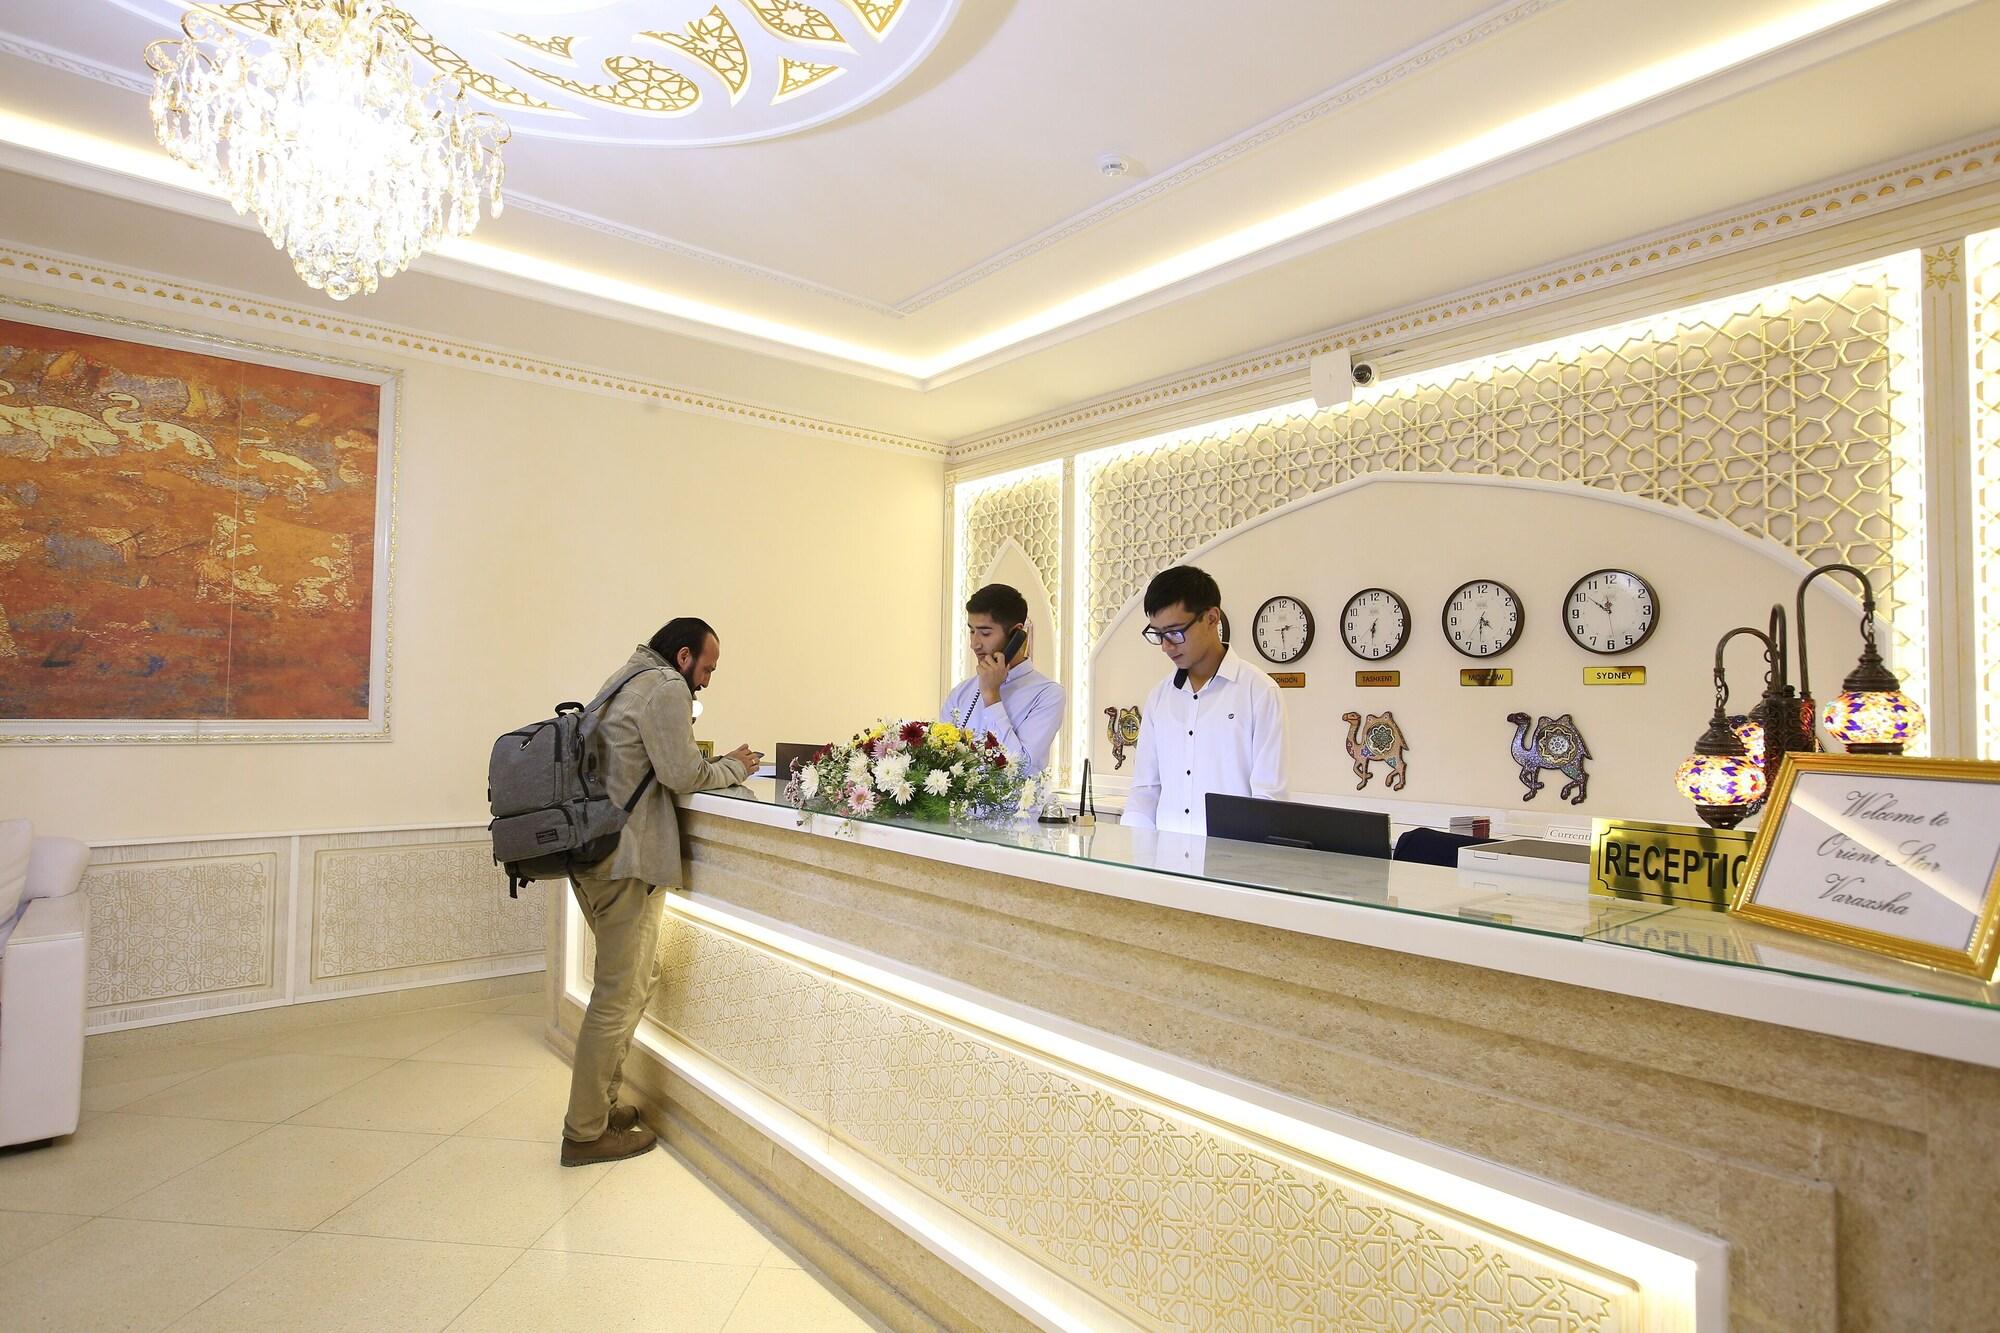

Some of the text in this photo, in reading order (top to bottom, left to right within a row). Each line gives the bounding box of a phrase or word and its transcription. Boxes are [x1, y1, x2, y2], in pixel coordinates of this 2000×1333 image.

[1604, 575, 1617, 584] 12
[1628, 578, 1631, 586] 1
[1477, 585, 1487, 594] 12
[1588, 581, 1597, 590] 11
[1463, 591, 1471, 599] 11
[1496, 588, 1499, 596] 1
[1638, 589, 1645, 598] 2
[1576, 593, 1586, 602] 10
[1279, 600, 1287, 608] 12
[1359, 598, 1366, 606] 11
[1453, 602, 1462, 610] 10
[1505, 598, 1511, 606] 2
[1350, 608, 1357, 616] 10
[1394, 605, 1399, 613] 2
[1643, 606, 1651, 615] 3
[1299, 611, 1304, 619] 2
[1510, 613, 1516, 622] 3
[1572, 610, 1579, 619] 9
[1451, 617, 1457, 625] 9
[1577, 625, 1584, 634] 8
[1639, 622, 1646, 631] 4
[1260, 628, 1264, 636] 9
[1455, 632, 1461, 640] 8
[1507, 628, 1513, 637] 4
[1590, 637, 1596, 646] 7
[1625, 635, 1633, 645] 5
[1466, 642, 1472, 650] 7
[1496, 641, 1502, 649] 5
[1607, 640, 1615, 649] 6
[1373, 648, 1378, 656] 6
[1481, 645, 1487, 653] 6
[1597, 672, 1632, 680] SYDNEY
[1843, 791, 1949, 827] Welcome to
[1817, 832, 1942, 872] Orient Star
